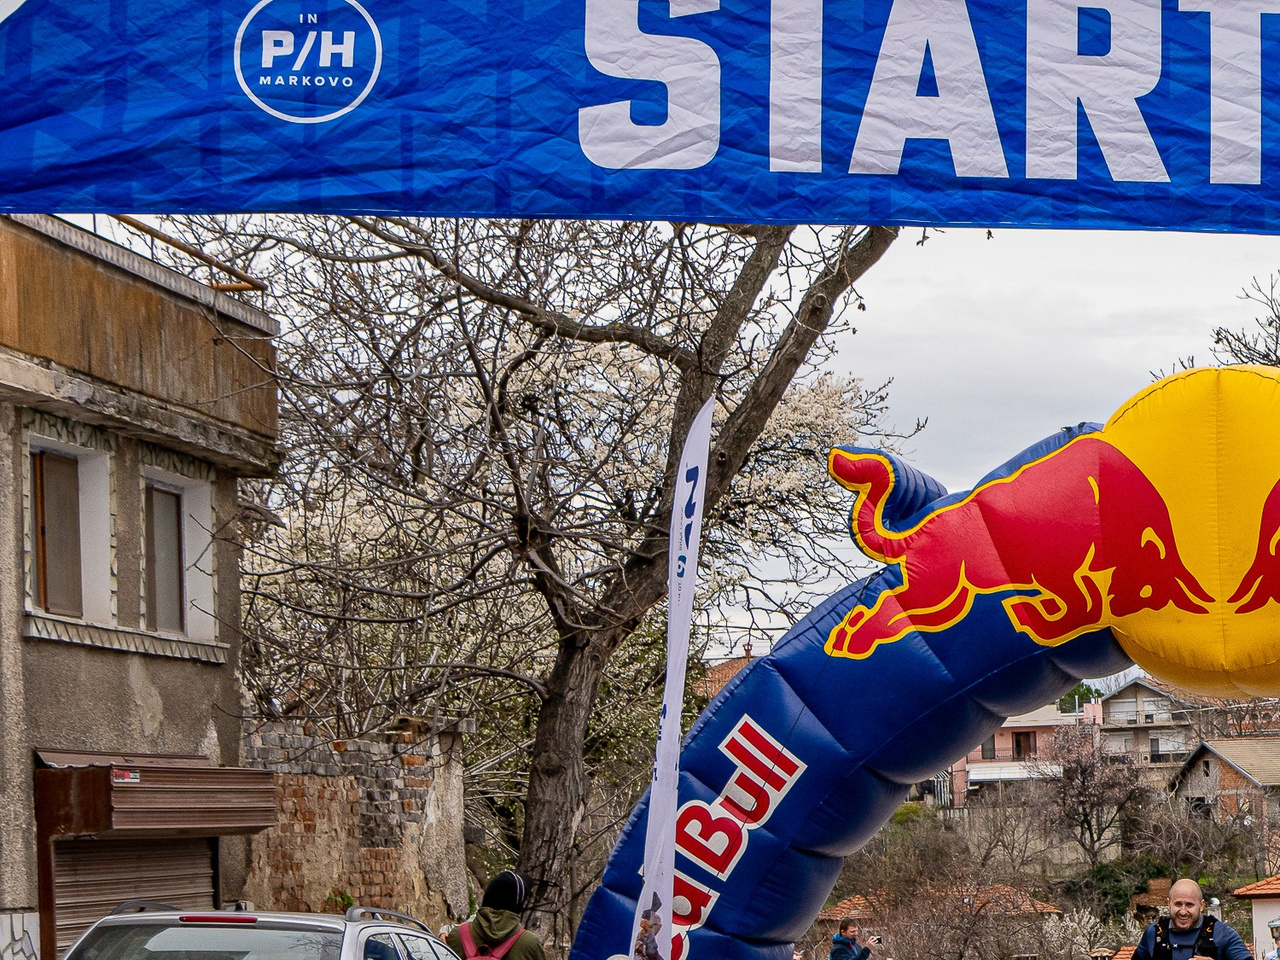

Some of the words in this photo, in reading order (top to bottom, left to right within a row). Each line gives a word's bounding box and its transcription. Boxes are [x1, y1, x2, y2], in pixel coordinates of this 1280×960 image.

[299, 13, 318, 24] IN
[261, 29, 356, 71] P/H
[259, 75, 354, 87] MARKOVO
[675, 716, 805, 879] Bull
